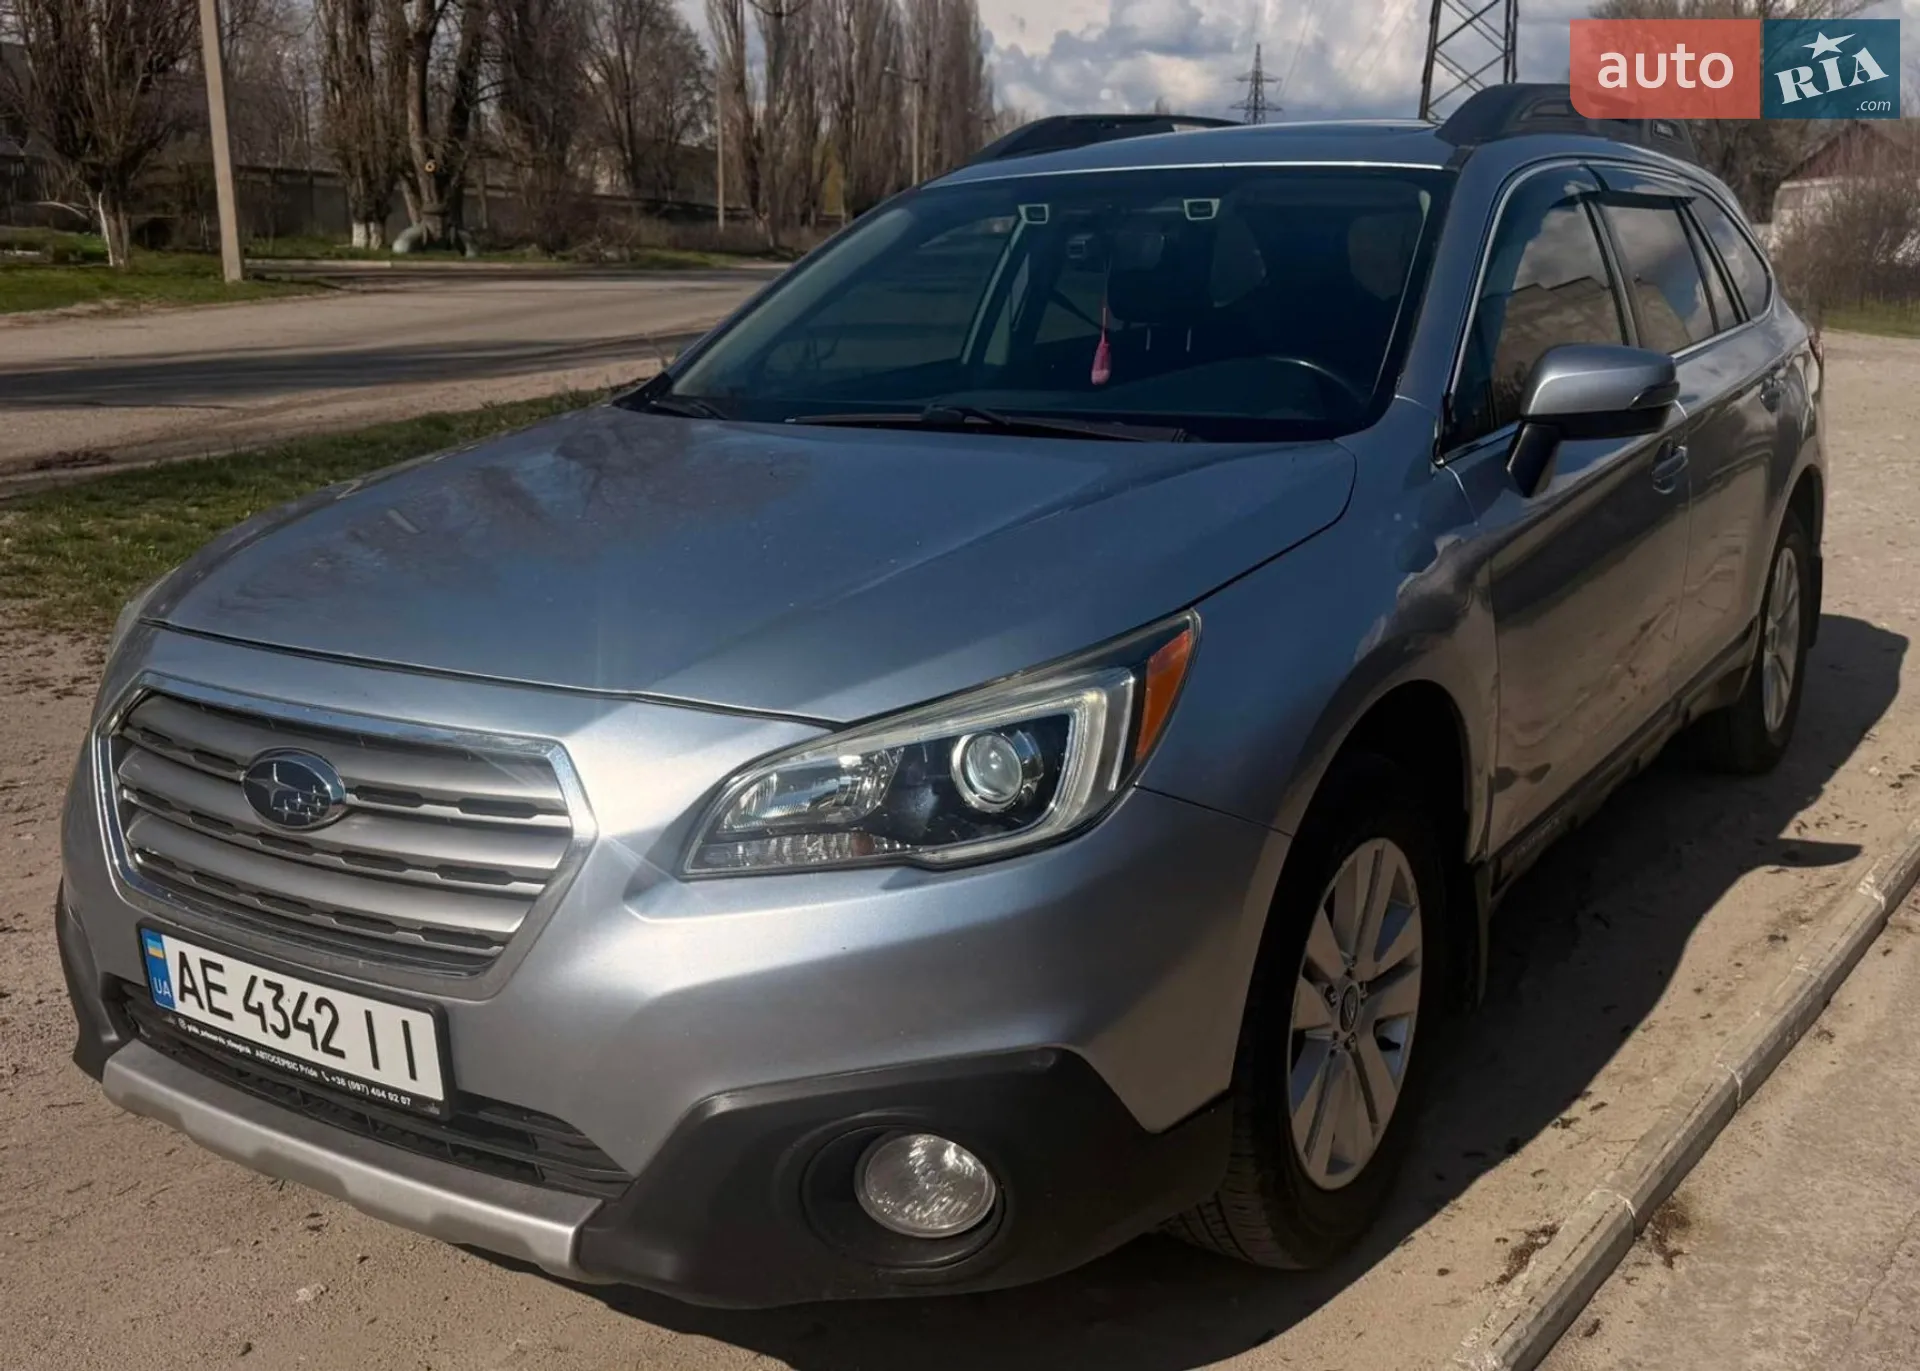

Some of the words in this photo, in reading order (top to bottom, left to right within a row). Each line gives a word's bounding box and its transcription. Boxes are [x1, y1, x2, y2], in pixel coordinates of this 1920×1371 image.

[152, 976, 172, 998] UA
[177, 951, 234, 1021] AE
[242, 975, 346, 1060] 4342
